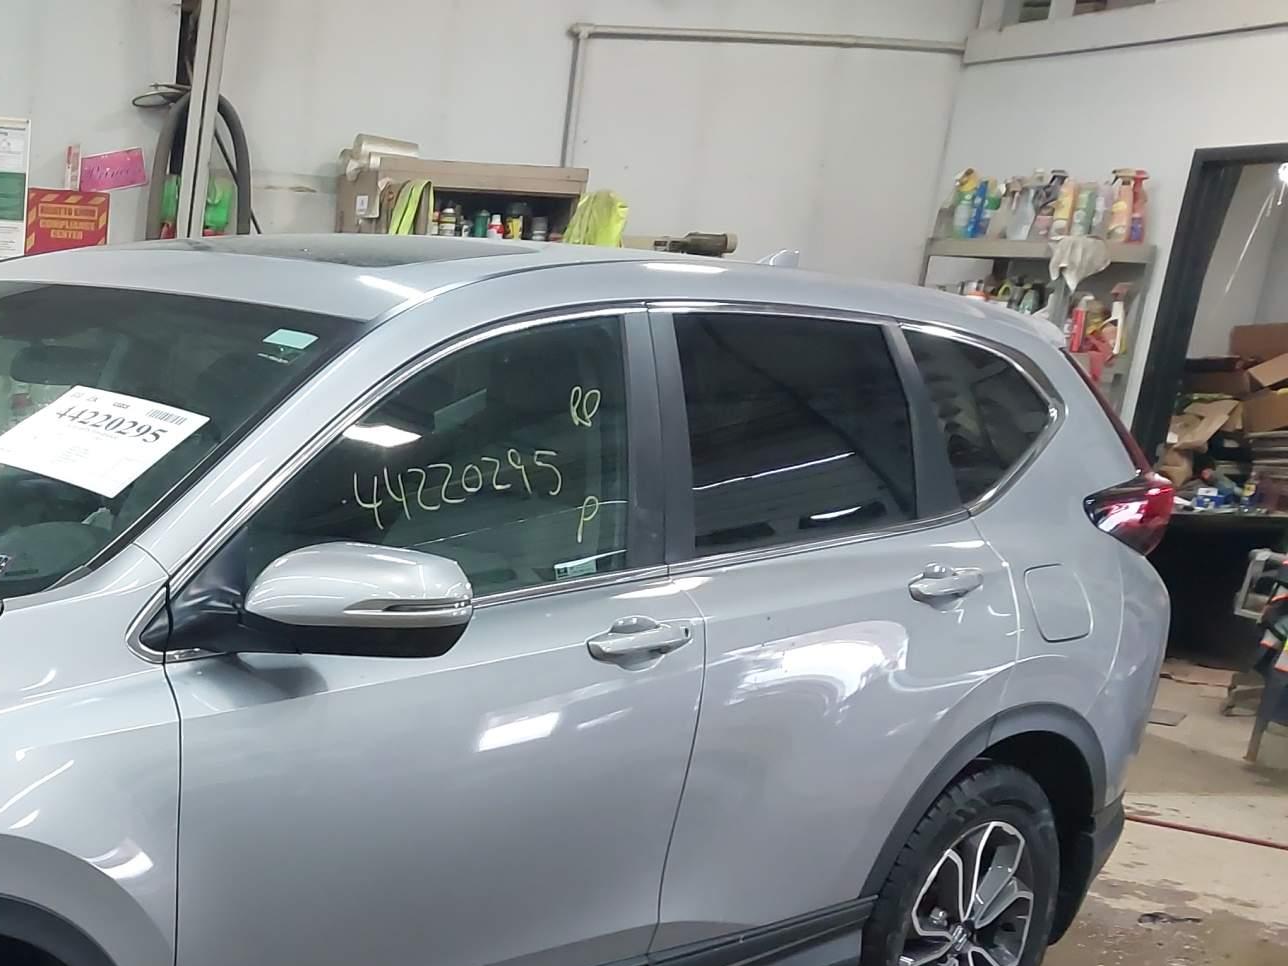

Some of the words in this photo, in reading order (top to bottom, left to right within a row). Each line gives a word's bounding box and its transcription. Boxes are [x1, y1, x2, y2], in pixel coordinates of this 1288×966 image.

[56, 405, 169, 444] 44220295
[353, 448, 562, 531] 44220295
[577, 495, 600, 544] P
